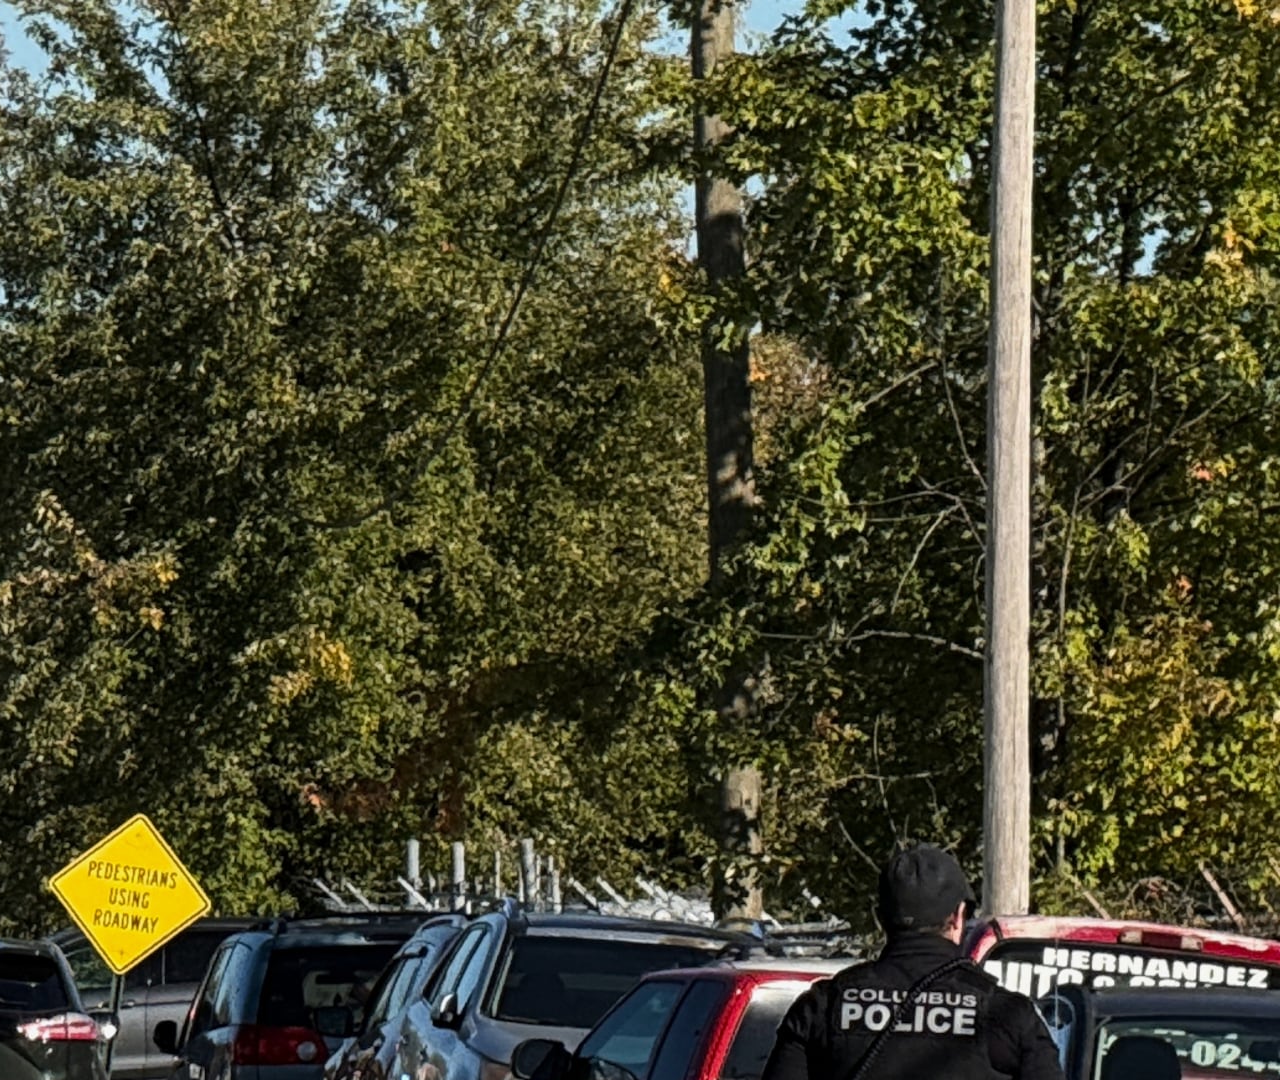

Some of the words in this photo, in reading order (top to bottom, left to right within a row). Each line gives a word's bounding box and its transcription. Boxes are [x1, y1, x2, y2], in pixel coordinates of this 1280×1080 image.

[87, 860, 178, 889] PEDESTRIANS
[108, 887, 150, 909] USING
[92, 908, 159, 934] ROADWAY
[1042, 947, 1269, 989] HERNANDEZ
[840, 1002, 977, 1036] POLICE
